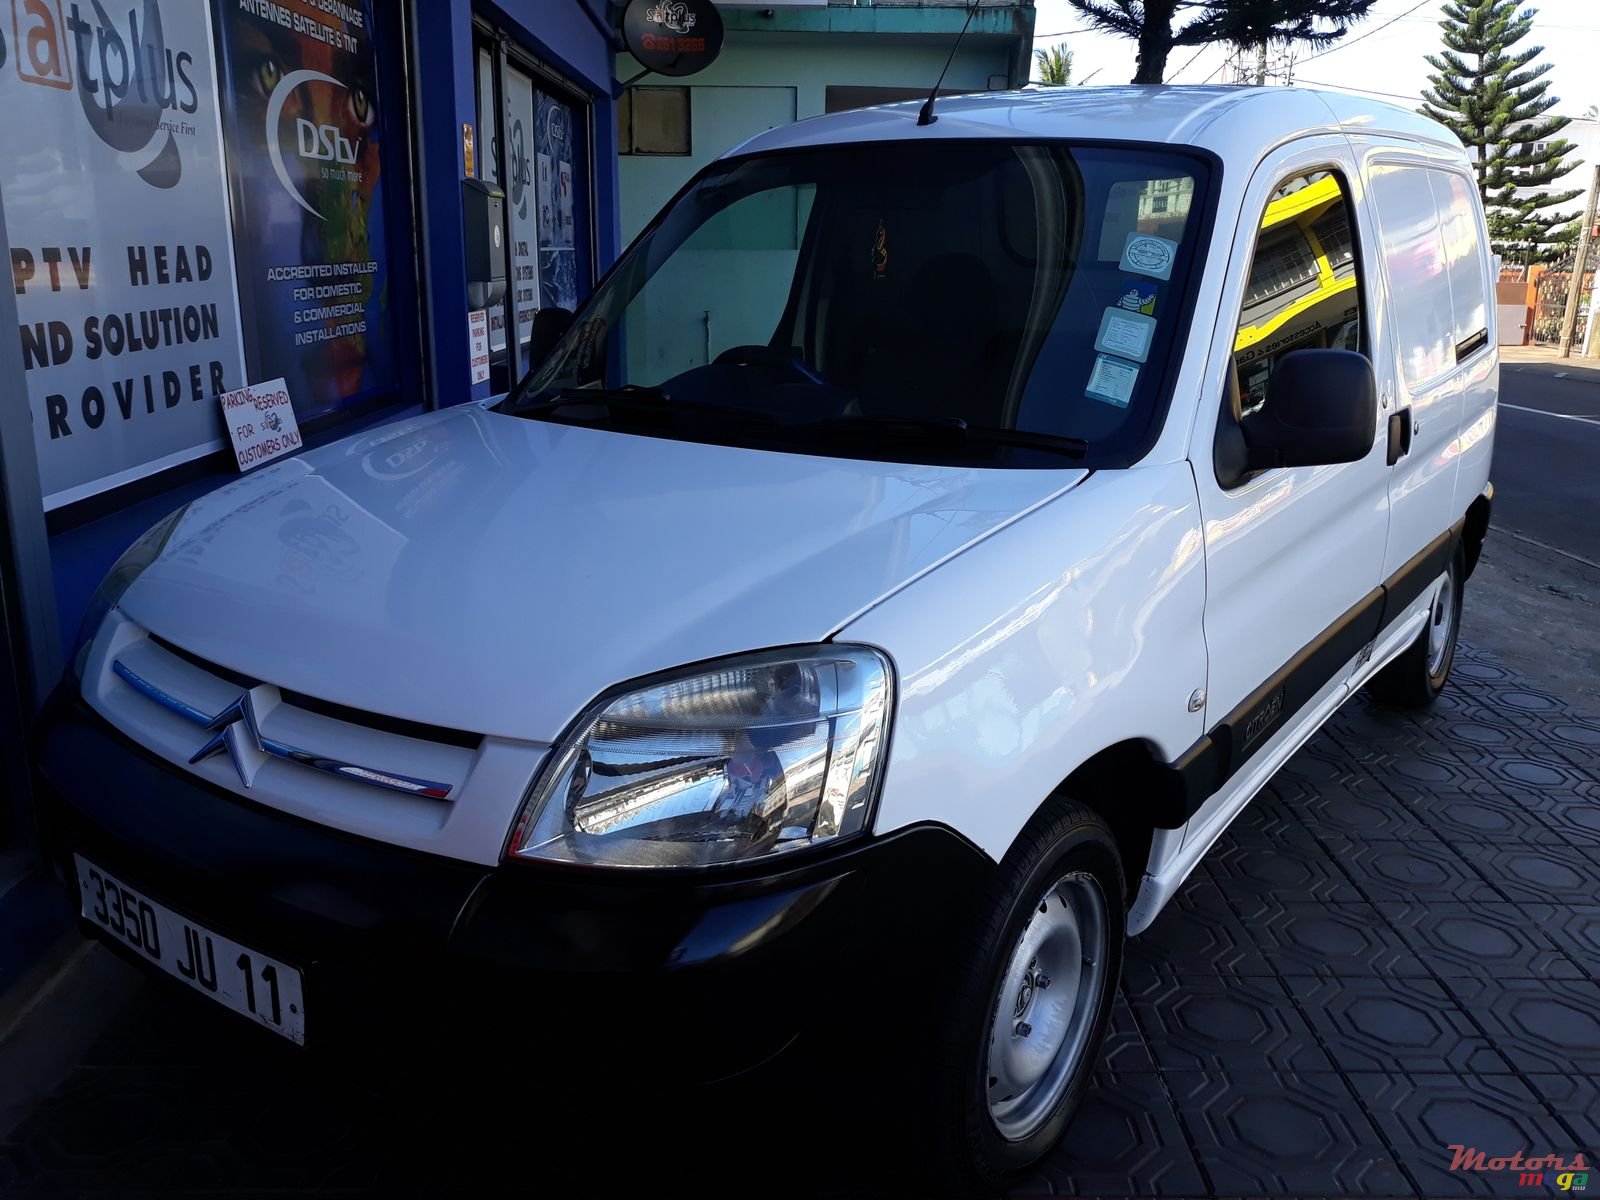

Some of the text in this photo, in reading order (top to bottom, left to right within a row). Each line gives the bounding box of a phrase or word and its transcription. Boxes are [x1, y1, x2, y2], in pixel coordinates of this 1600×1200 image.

[240, 0, 292, 29] ANTENNES
[293, 13, 336, 46] SATELLITE
[343, 33, 358, 54] TNT
[0, 0, 198, 121] atplus
[321, 167, 363, 183] so much more
[127, 245, 213, 287] HEAD
[267, 261, 378, 281] ACCREDITED INSTALLER
[293, 283, 363, 302] FOR DOMESTIC
[294, 302, 365, 323] & COMMERCIAL
[84, 303, 220, 360] SOLUTION
[295, 321, 367, 346] INSTALLATIONS
[31, 361, 227, 440] ROVIDER
[221, 388, 289, 412] PARKING RESERVED
[236, 423, 256, 441] FOR
[238, 430, 301, 466] CUSTOMERS ONLY
[89, 868, 281, 1026] 3350 JU 11
